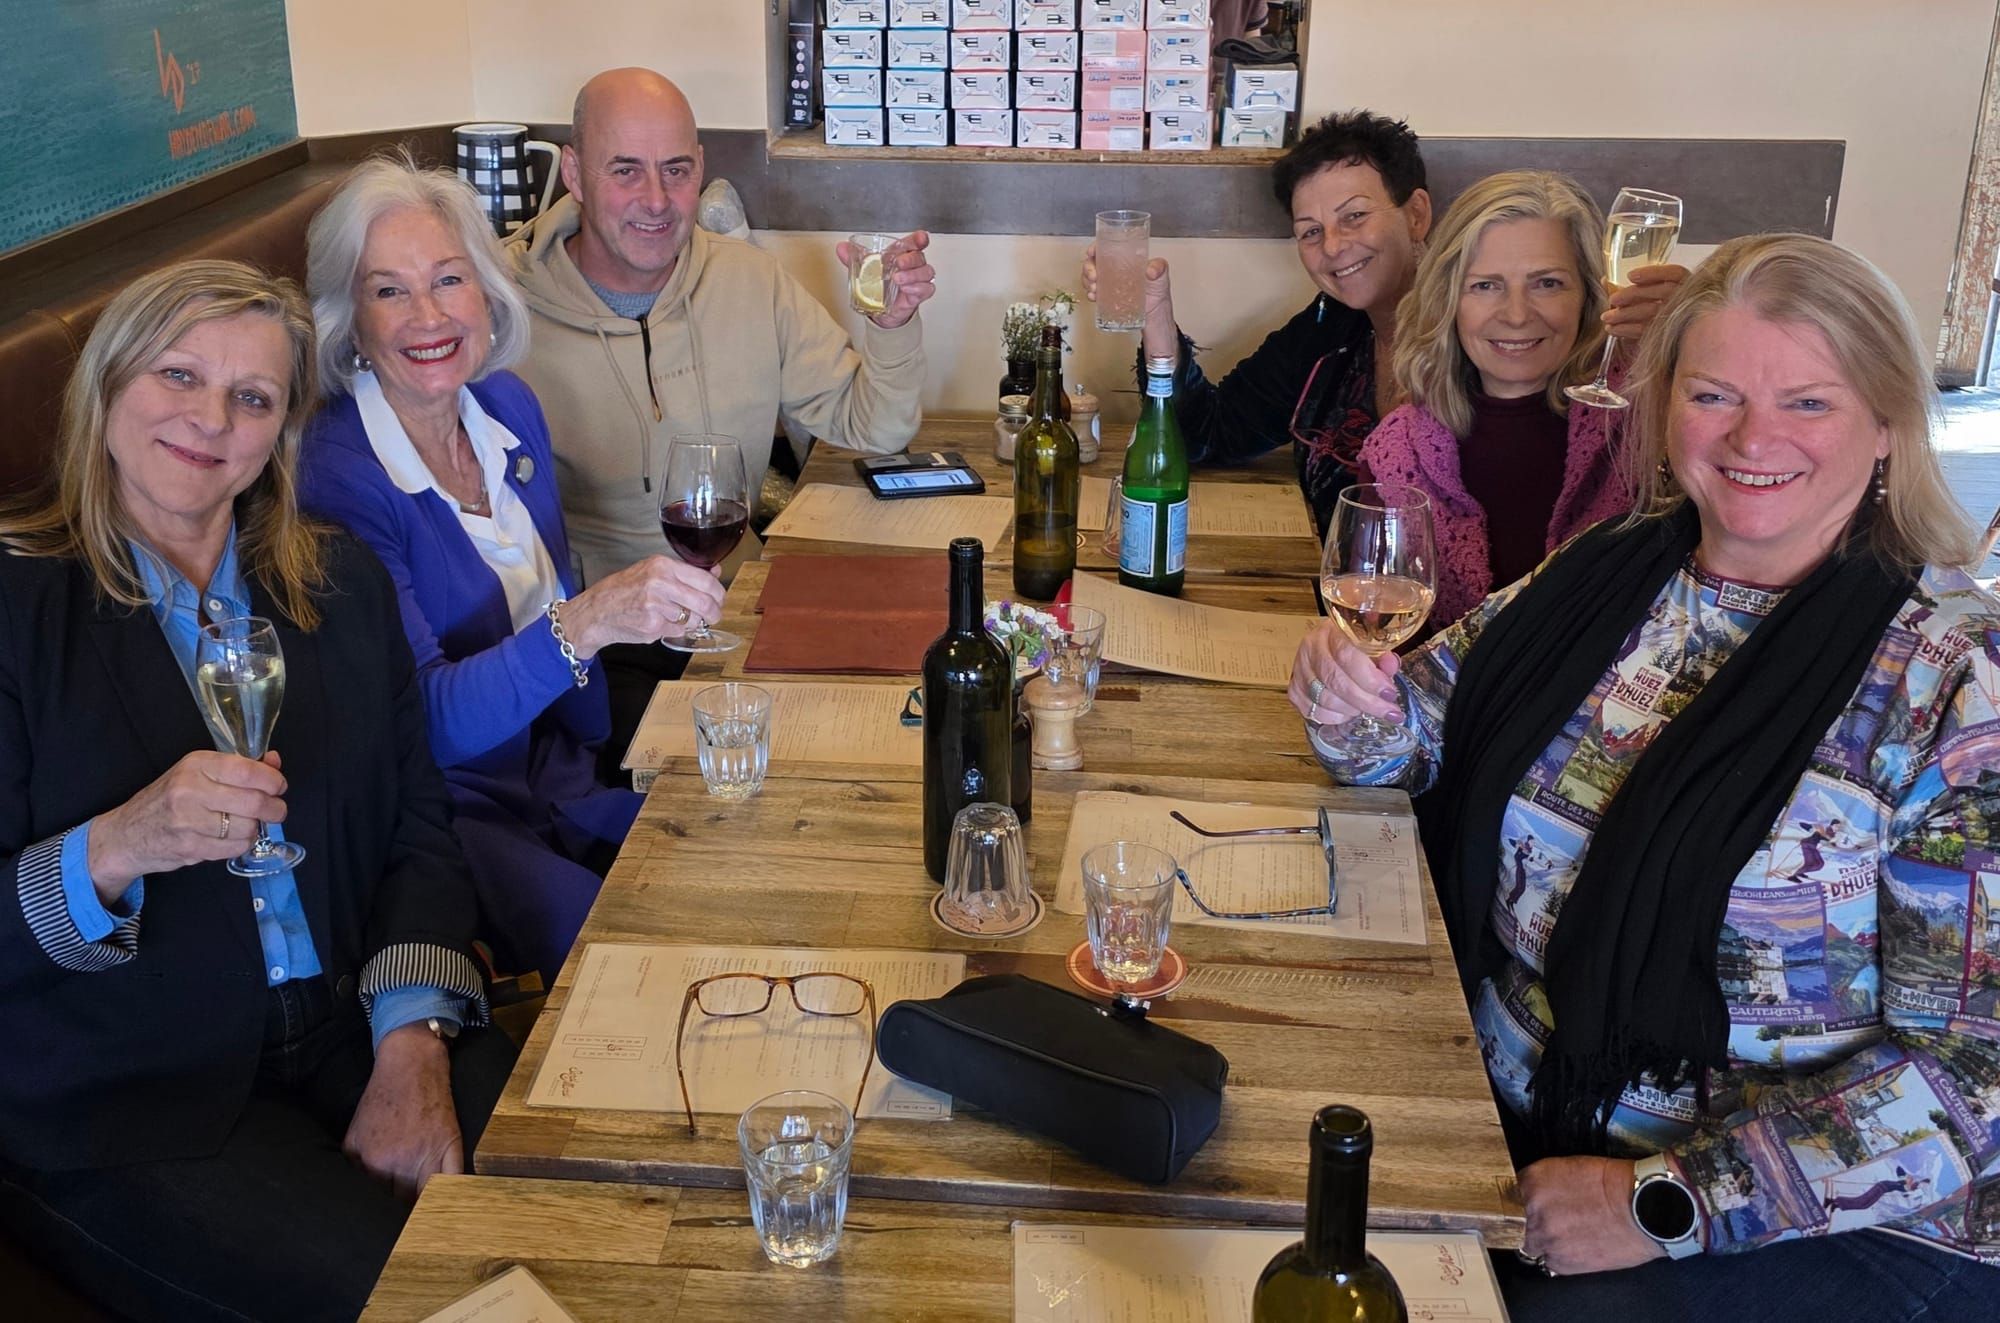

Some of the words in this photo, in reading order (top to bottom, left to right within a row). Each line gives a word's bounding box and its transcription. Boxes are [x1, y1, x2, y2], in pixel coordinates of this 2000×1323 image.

[1941, 631, 1972, 651] HUE
[1633, 671, 1662, 691] HUEZ
[1541, 790, 1567, 808] ROUTE
[1567, 803, 1583, 815] DES
[1728, 1006, 1801, 1017] CAUTERETS
[1938, 1078, 1983, 1138] CAUTERETS
